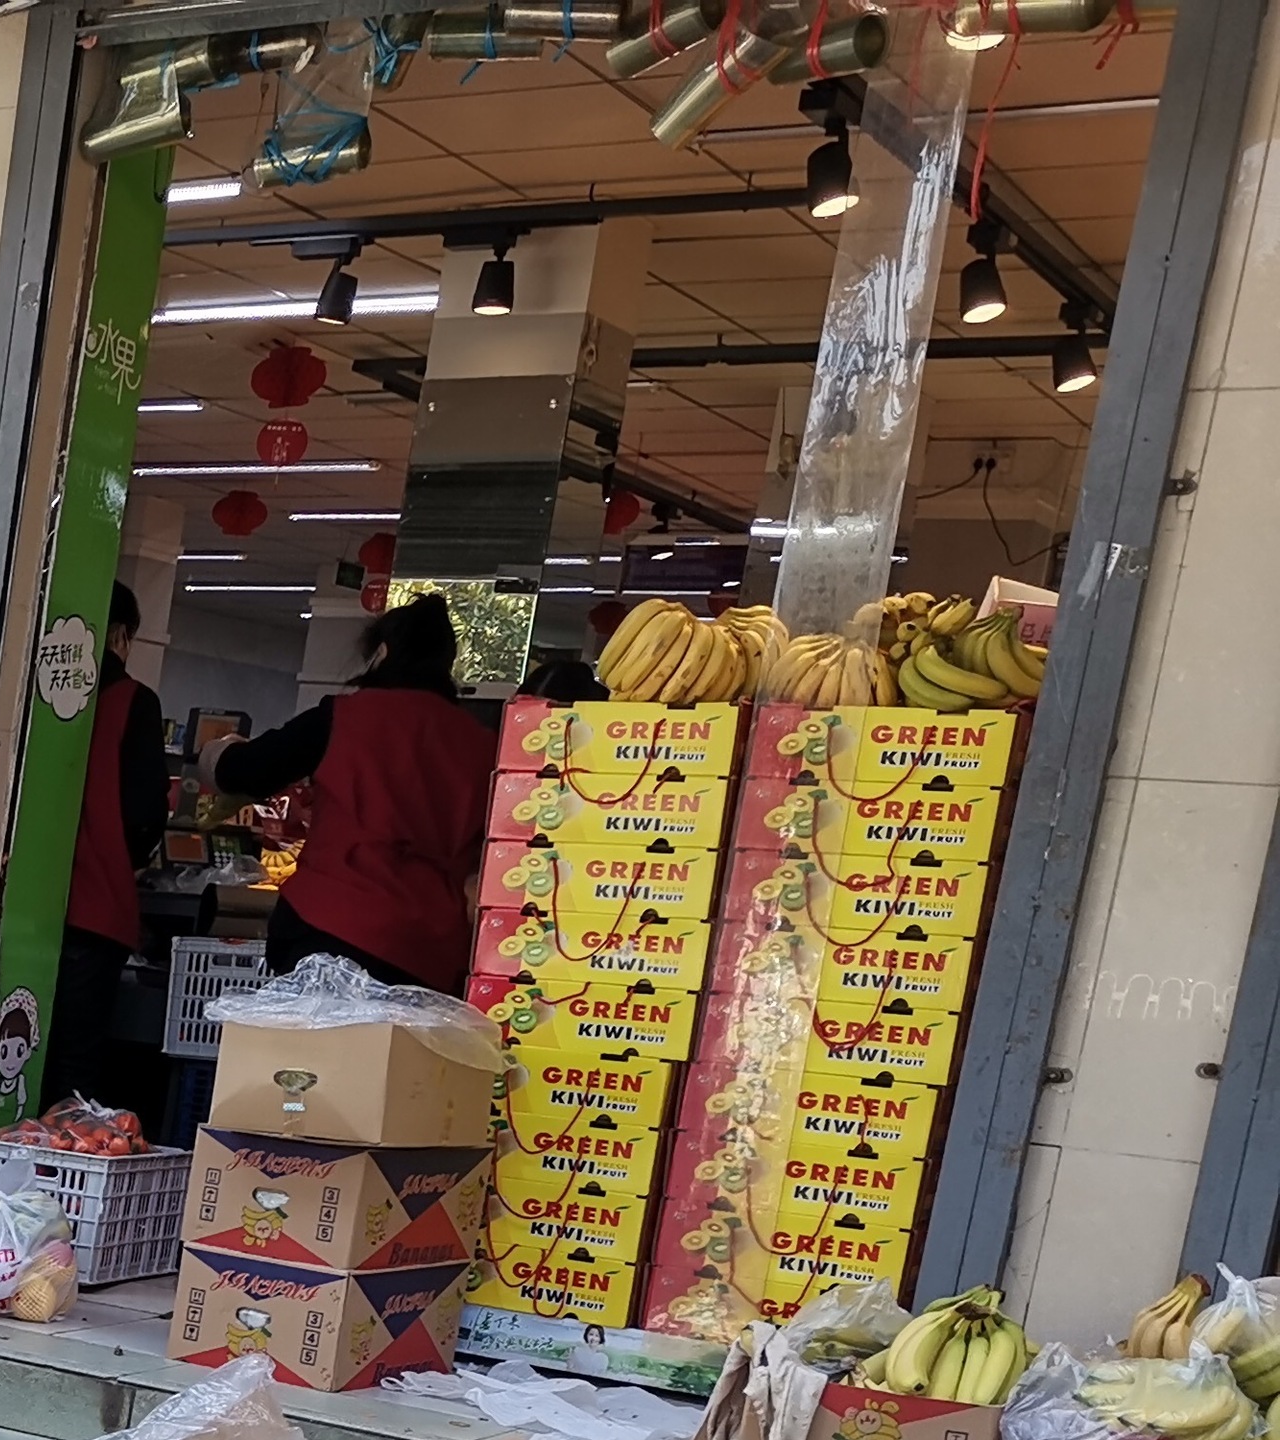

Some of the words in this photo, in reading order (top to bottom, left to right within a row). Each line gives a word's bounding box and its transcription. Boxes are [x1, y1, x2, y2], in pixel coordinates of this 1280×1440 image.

[85, 318, 141, 405] 水果
[39, 643, 83, 667] 天天新鲜
[49, 668, 95, 694] 天天省心
[606, 721, 711, 739] GREEN
[871, 725, 987, 746] GREEN
[616, 745, 670, 760] KIWI
[880, 751, 942, 766] KIWI
[944, 760, 980, 768] FRUIT
[597, 792, 701, 812] GREEN
[857, 801, 973, 822] GREEN
[606, 816, 661, 832] KIWI
[662, 825, 695, 833] FRUIT
[866, 825, 928, 842] KIWI
[930, 835, 965, 843] FRUIT
[586, 860, 689, 881] GREEN
[595, 884, 650, 900] KIWI
[652, 893, 684, 901] FRUIT
[845, 874, 960, 897] GREEN
[855, 899, 916, 916] KIWI
[918, 909, 953, 918] FRUIT
[582, 931, 684, 954] GREEN
[590, 955, 645, 971] KIWI
[647, 965, 679, 974] FRUIT
[833, 947, 946, 972] GREEN
[842, 972, 902, 990] KIWI
[905, 984, 940, 993] FRUIT
[569, 999, 671, 1024] GREEN
[578, 1023, 633, 1040] KIWI
[634, 1034, 665, 1043] FRUIT
[820, 1020, 931, 1046] GREEN
[890, 1058, 925, 1067] FRUIT
[542, 1067, 643, 1092] GREEN
[551, 1090, 604, 1108] KIWI
[605, 1103, 637, 1112] FRUIT
[797, 1091, 908, 1119] GREEN
[533, 1132, 633, 1158] GREEN
[866, 1131, 901, 1140] FRUIT
[542, 1156, 595, 1174] KIWI
[596, 1169, 627, 1178] FRUIT
[786, 1161, 896, 1190] GREEN
[328, 1189, 335, 1201] 3
[794, 1186, 852, 1205] KIWI
[854, 1200, 889, 1211] FRUIT
[324, 1208, 333, 1221] 4
[522, 1199, 621, 1227] GREEN
[321, 1227, 329, 1240] 5
[530, 1222, 583, 1241] KIWI
[584, 1236, 615, 1246] FRUIT
[388, 1242, 453, 1266] Bananas
[772, 1231, 881, 1262] GREEN
[512, 1263, 611, 1292] GREEN
[779, 1257, 839, 1277] KIWI
[839, 1271, 874, 1282] FRUIT
[520, 1285, 572, 1305] KIWI
[574, 1301, 604, 1311] FRUIT
[311, 1313, 320, 1326] 3
[307, 1332, 316, 1345] 4
[304, 1350, 312, 1364] 5
